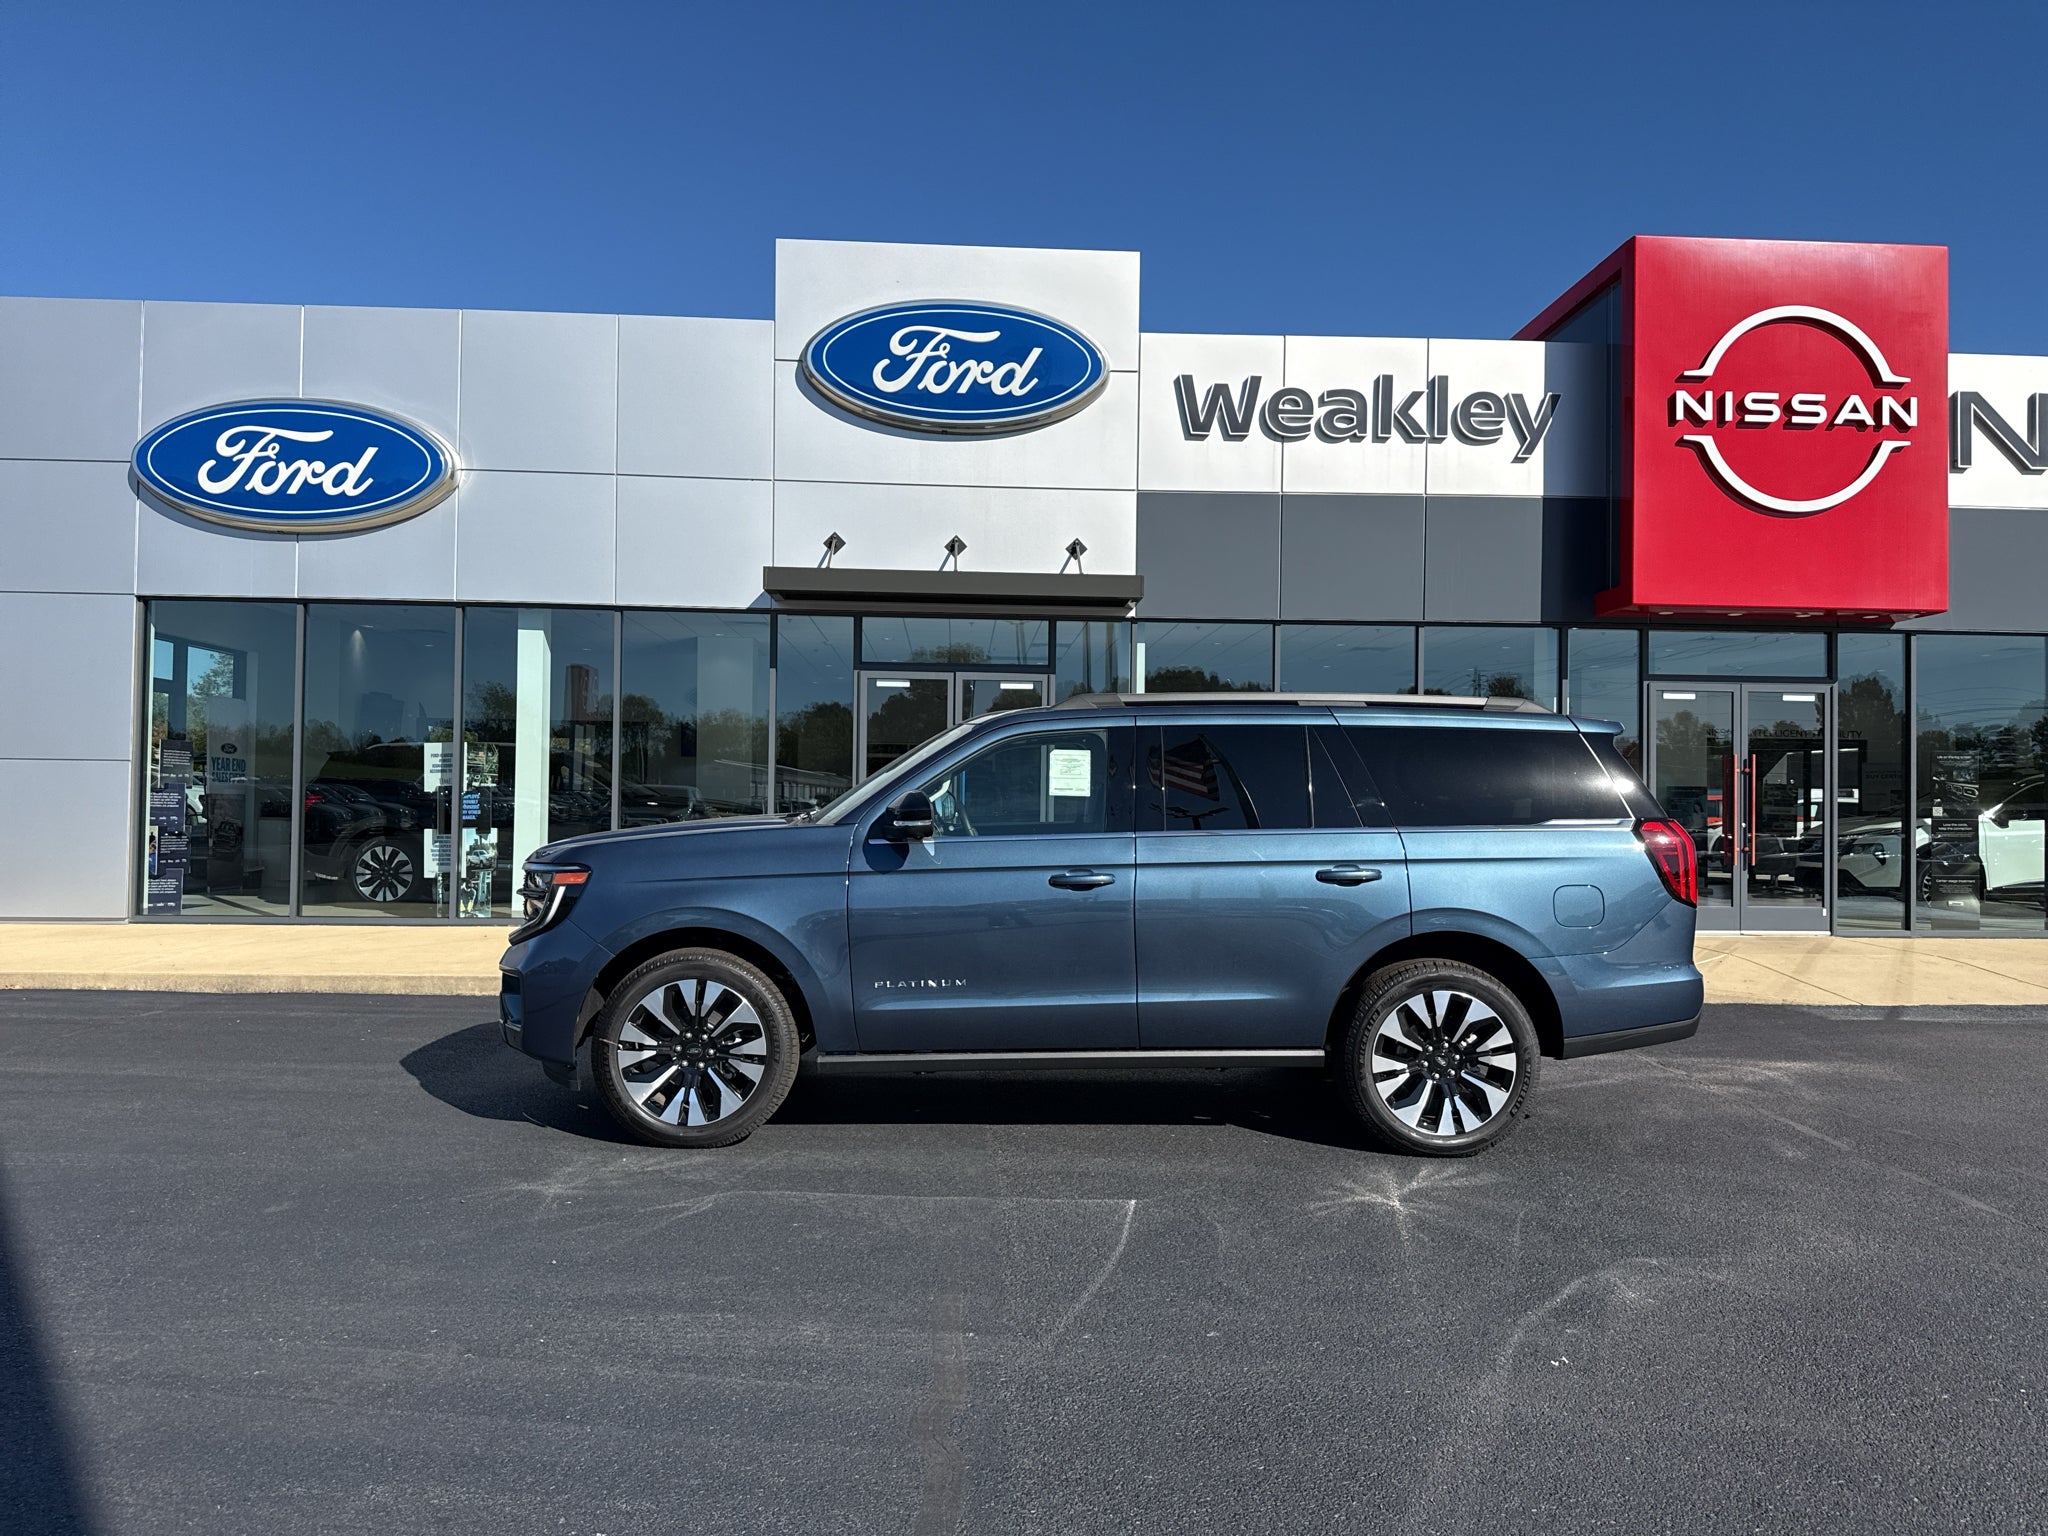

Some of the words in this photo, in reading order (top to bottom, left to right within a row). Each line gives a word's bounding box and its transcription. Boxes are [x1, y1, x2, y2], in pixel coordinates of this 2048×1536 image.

[873, 326, 1043, 396] Ford
[1174, 375, 1561, 464] Weakley
[1675, 390, 1918, 427] NISSAN
[198, 426, 379, 497] Ford
[211, 756, 231, 772] YEAR
[231, 757, 246, 772] END
[874, 979, 967, 989] PLATINUM
[1357, 1011, 1381, 1064] MICHELIN
[1509, 1062, 1531, 1115] MICHELIN
